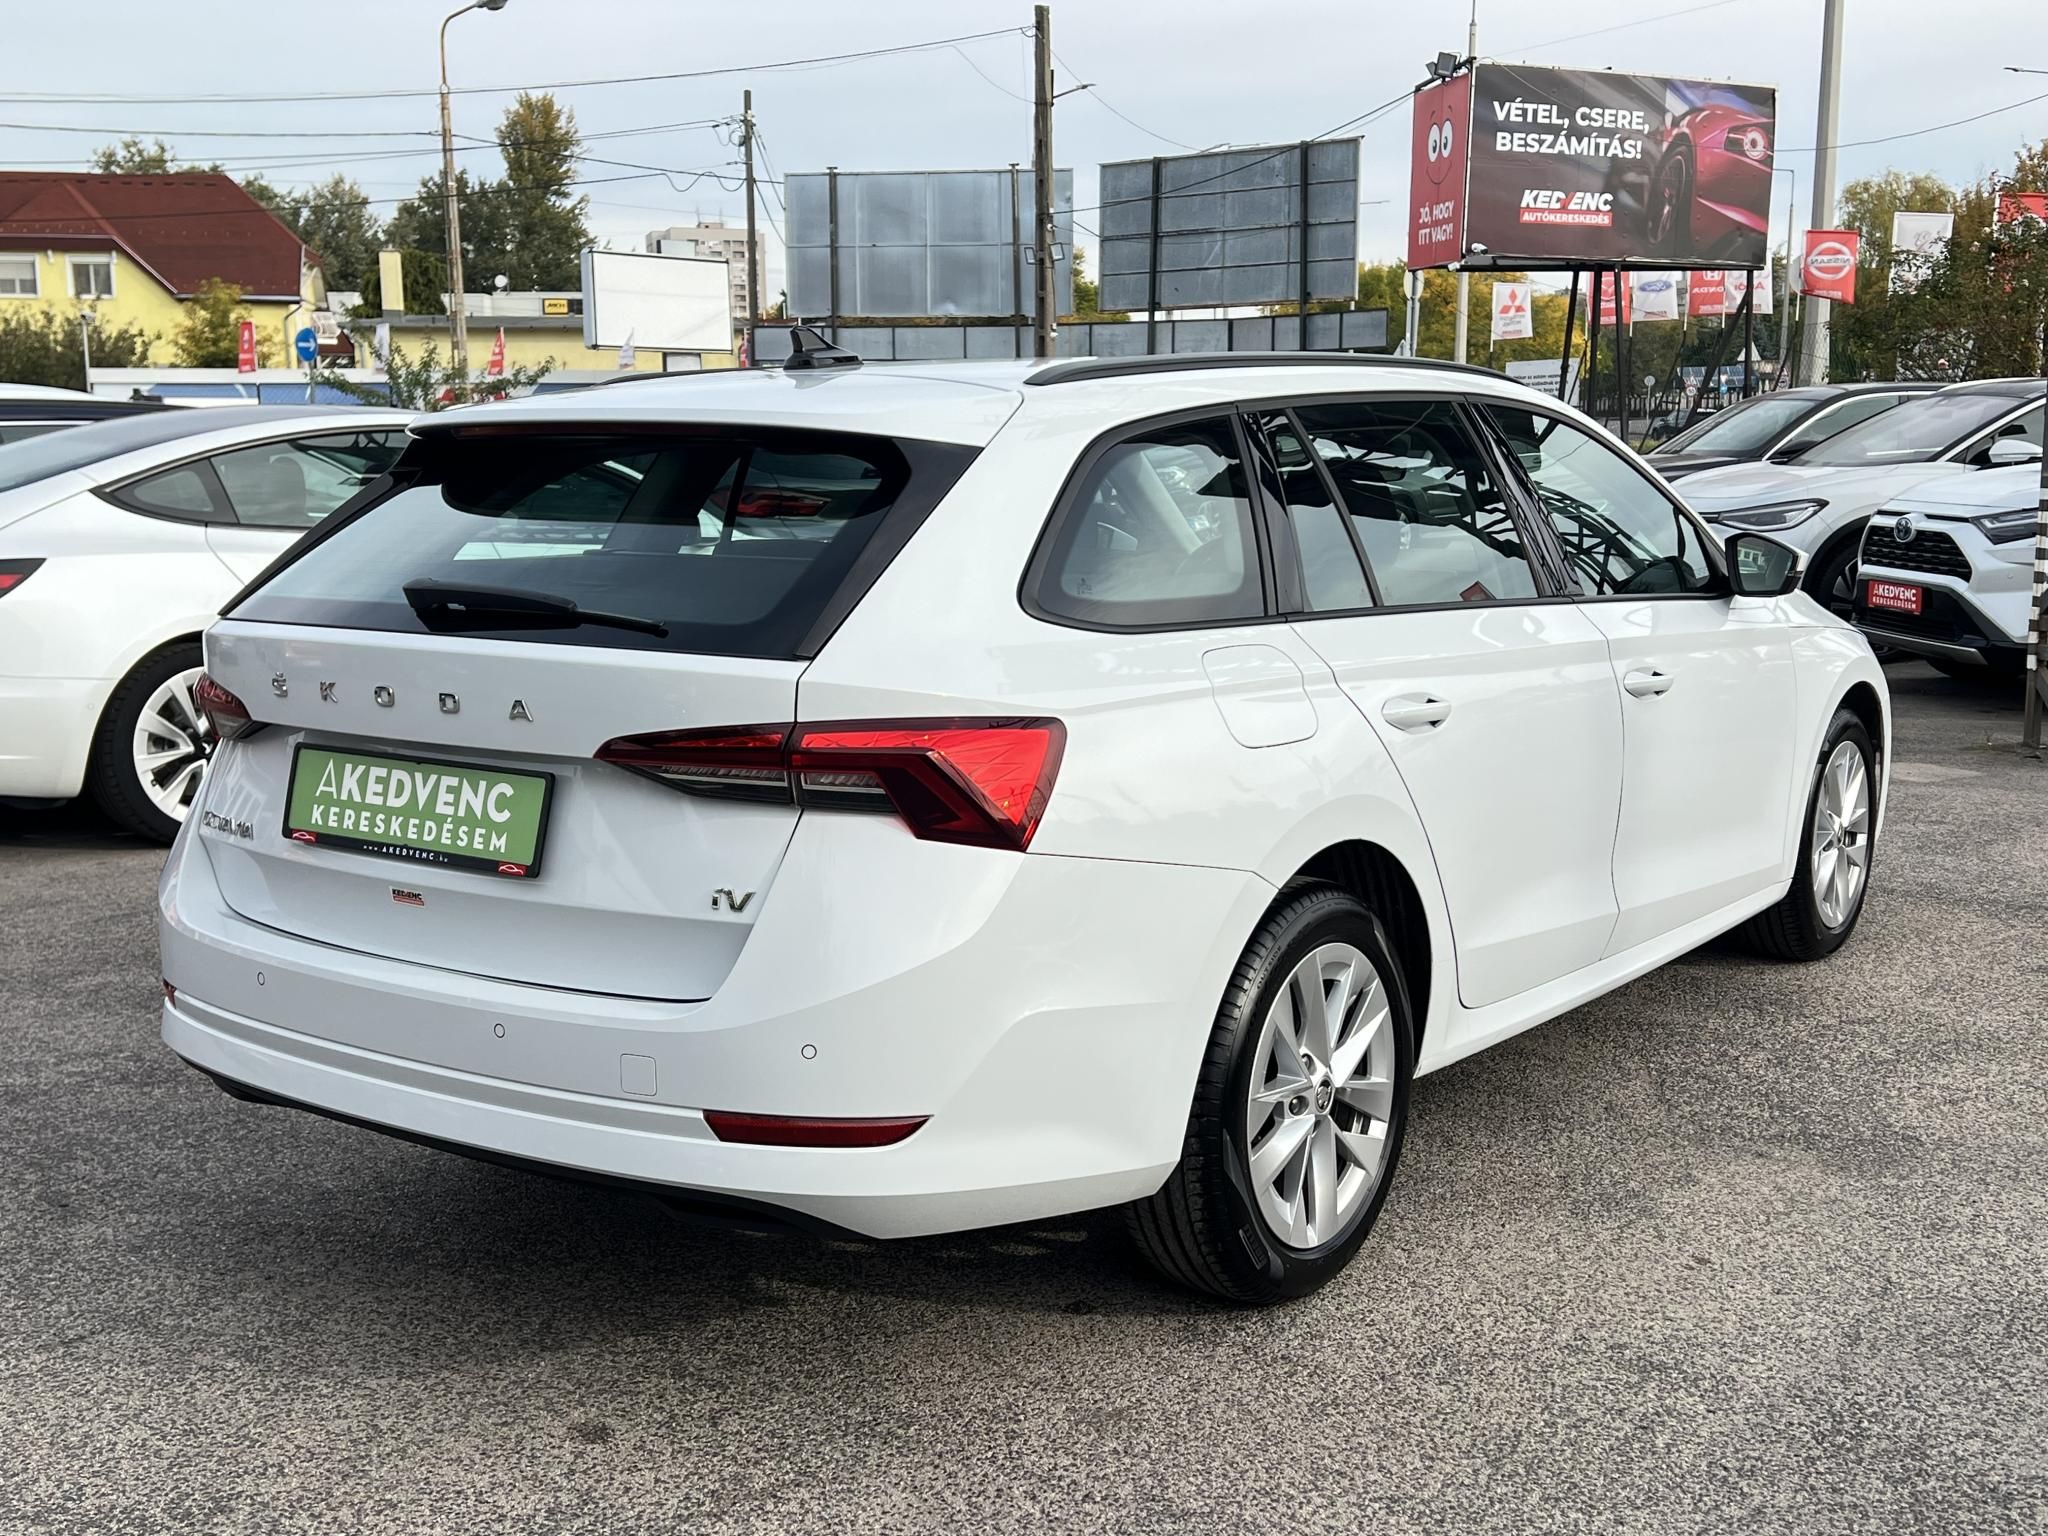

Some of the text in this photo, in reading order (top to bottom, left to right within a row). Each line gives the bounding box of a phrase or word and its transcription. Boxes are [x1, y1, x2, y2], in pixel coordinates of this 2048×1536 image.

[1493, 97, 1650, 134] VÉTEL, CSERE,
[1496, 130, 1643, 160] BESZÁMÍTÁS!
[1419, 200, 1455, 225] JÓ, HOGY
[1522, 212, 1610, 224] AUTÓKERESKEDÉS
[1418, 223, 1454, 246] ITT VAGY!
[1873, 584, 1916, 600] AKEDVENC
[272, 672, 534, 722] ŠKODA
[315, 758, 515, 823] AKEDVENC
[311, 804, 507, 854] KERESKEDÉSEM
